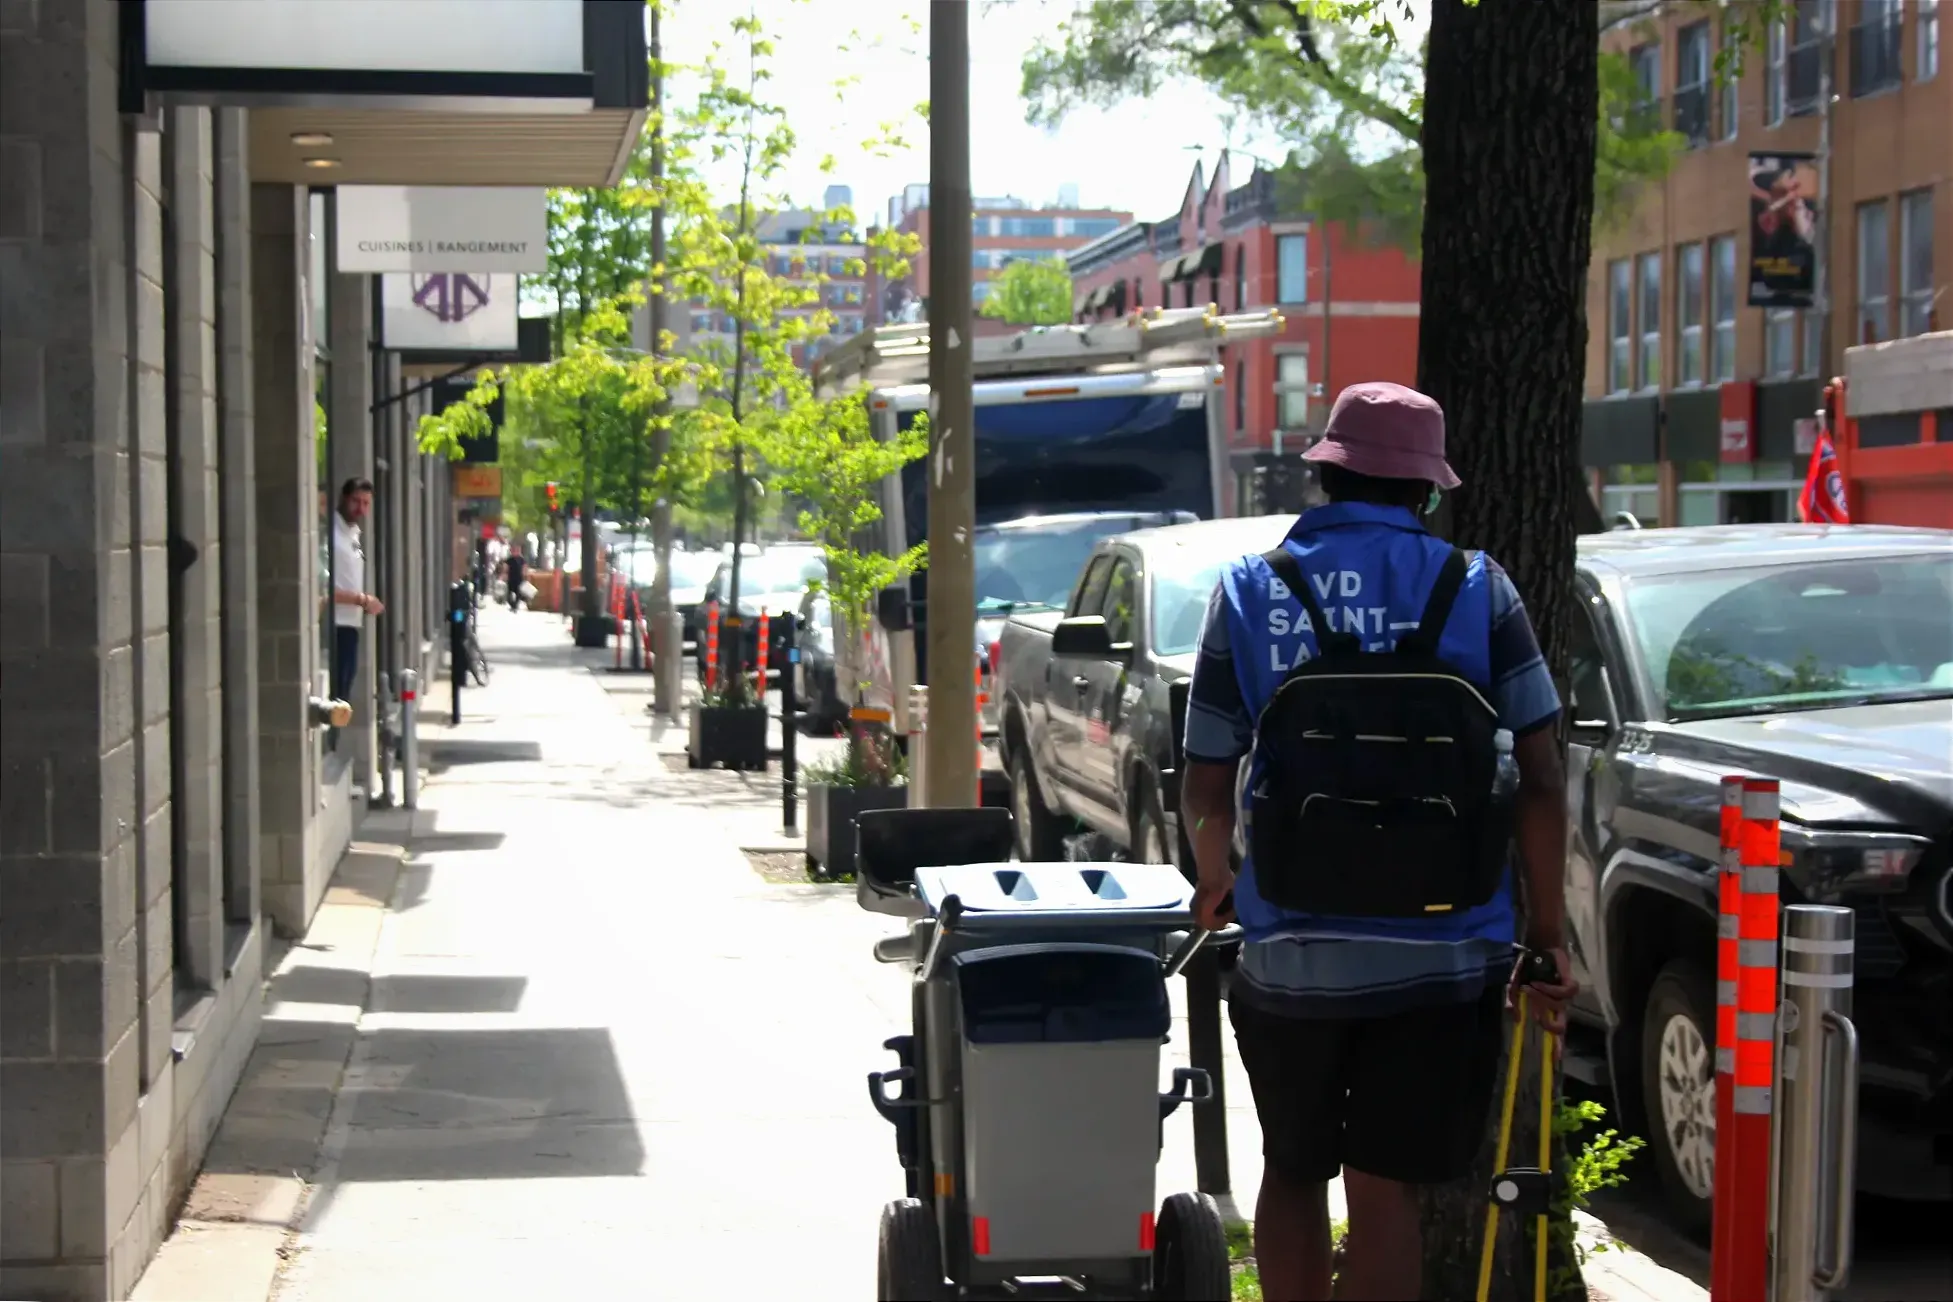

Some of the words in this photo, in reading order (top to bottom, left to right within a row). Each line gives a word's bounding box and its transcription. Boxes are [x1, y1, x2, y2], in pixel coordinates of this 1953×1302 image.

[358, 241, 424, 253] CUISINES
[436, 241, 528, 254] RANGEMENT
[1269, 570, 1362, 600] BVD
